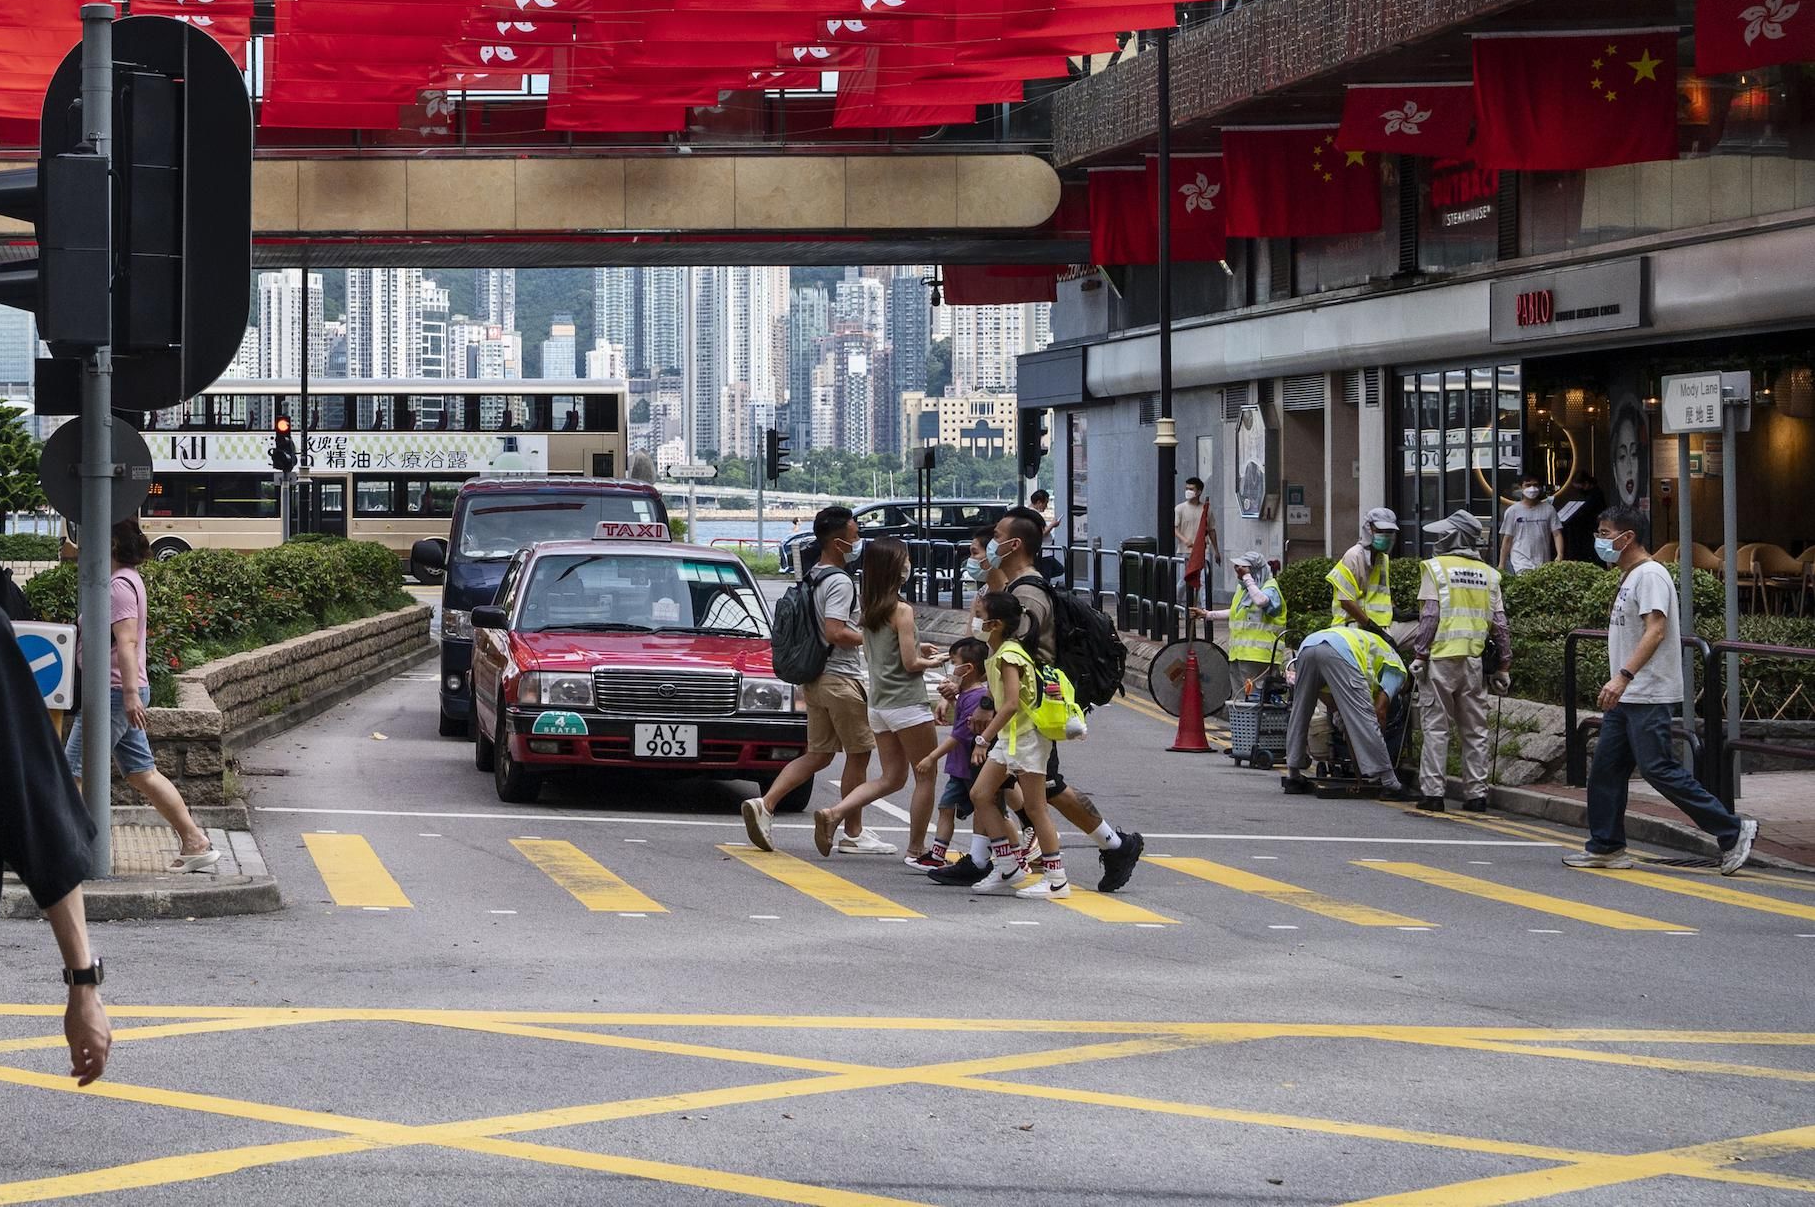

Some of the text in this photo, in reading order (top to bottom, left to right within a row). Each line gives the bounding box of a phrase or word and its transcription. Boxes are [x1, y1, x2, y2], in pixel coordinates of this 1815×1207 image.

[1515, 290, 1553, 326] PABLO
[1680, 381, 1718, 398] Mody Lane
[326, 450, 469, 469] 精油水療浴露
[602, 523, 663, 538] TAXI
[554, 716, 566, 727] 4
[652, 725, 680, 741] AY
[646, 740, 687, 756] 903
